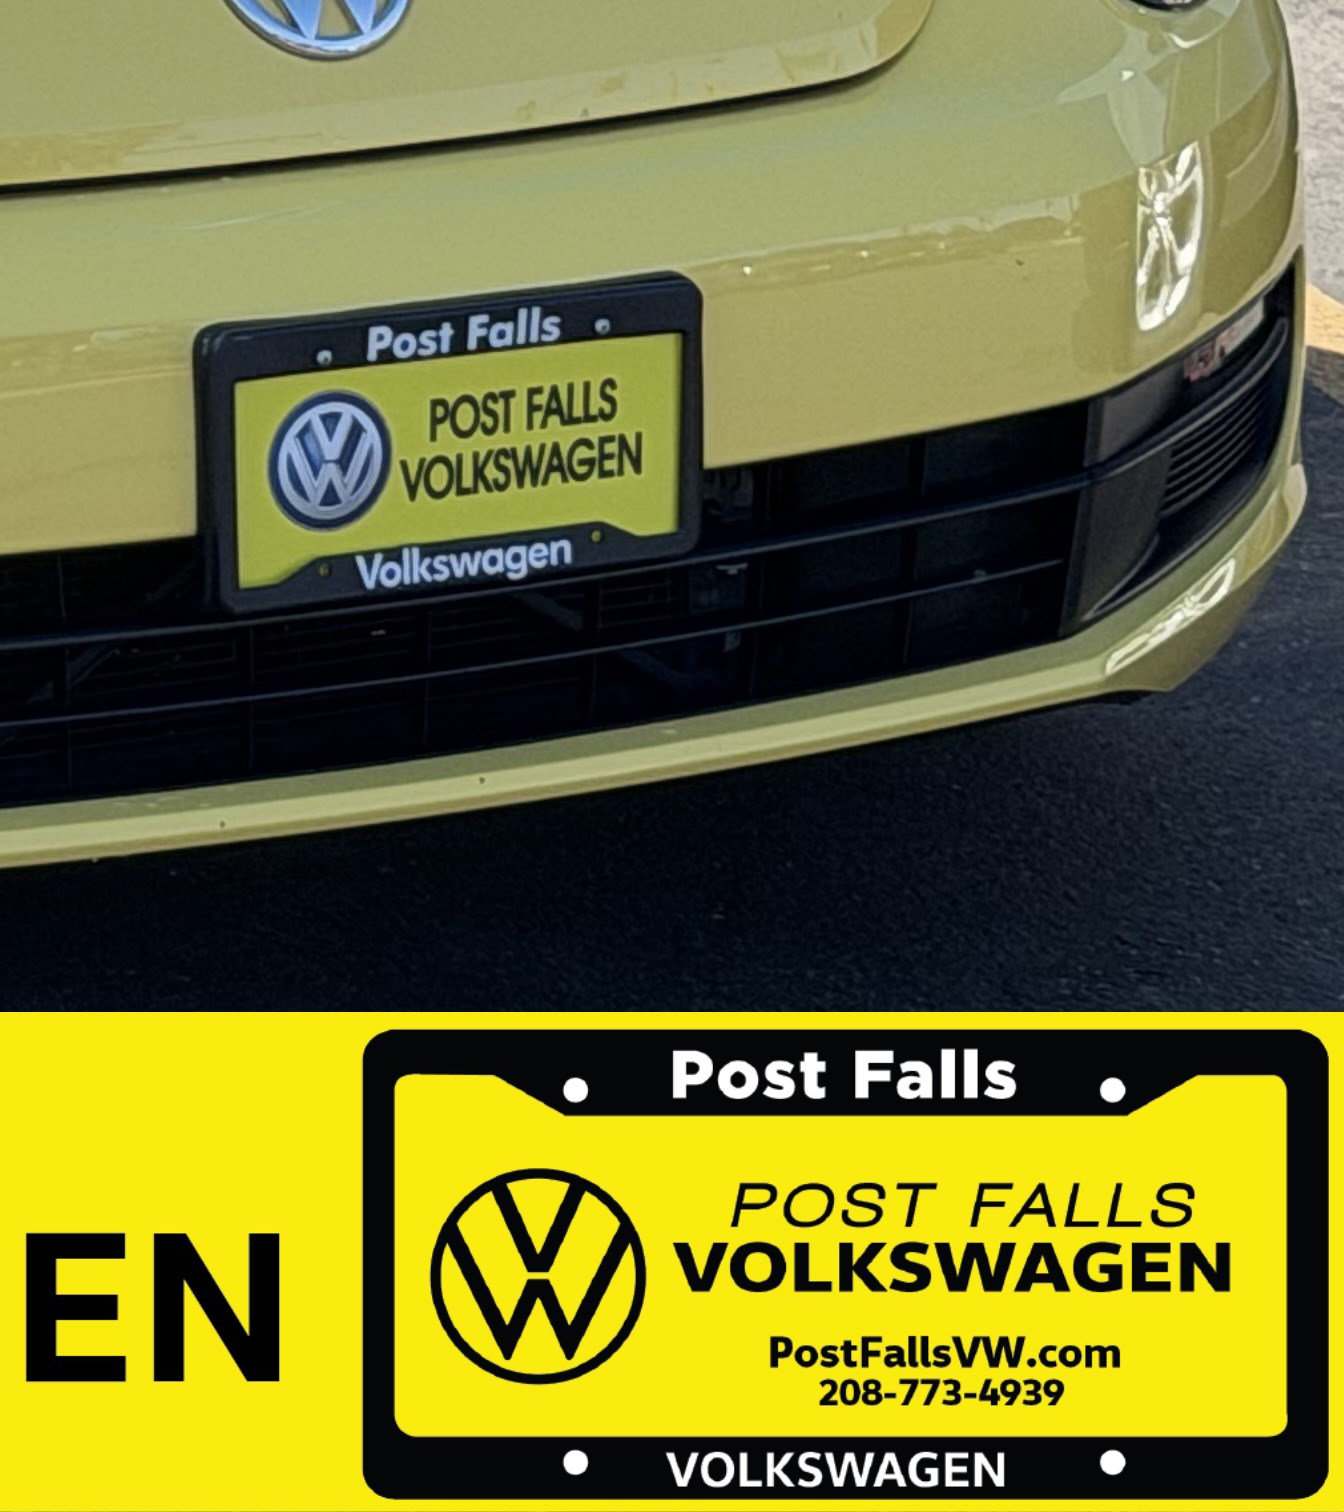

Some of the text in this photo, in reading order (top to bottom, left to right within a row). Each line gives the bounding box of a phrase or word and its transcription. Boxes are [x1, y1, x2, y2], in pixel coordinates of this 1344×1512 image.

[365, 306, 562, 363] Post Falls
[428, 377, 618, 443] POST FALLS
[274, 396, 387, 526] VW
[400, 431, 643, 503] VOLKSWAGEN
[355, 538, 572, 590] Volkswagen
